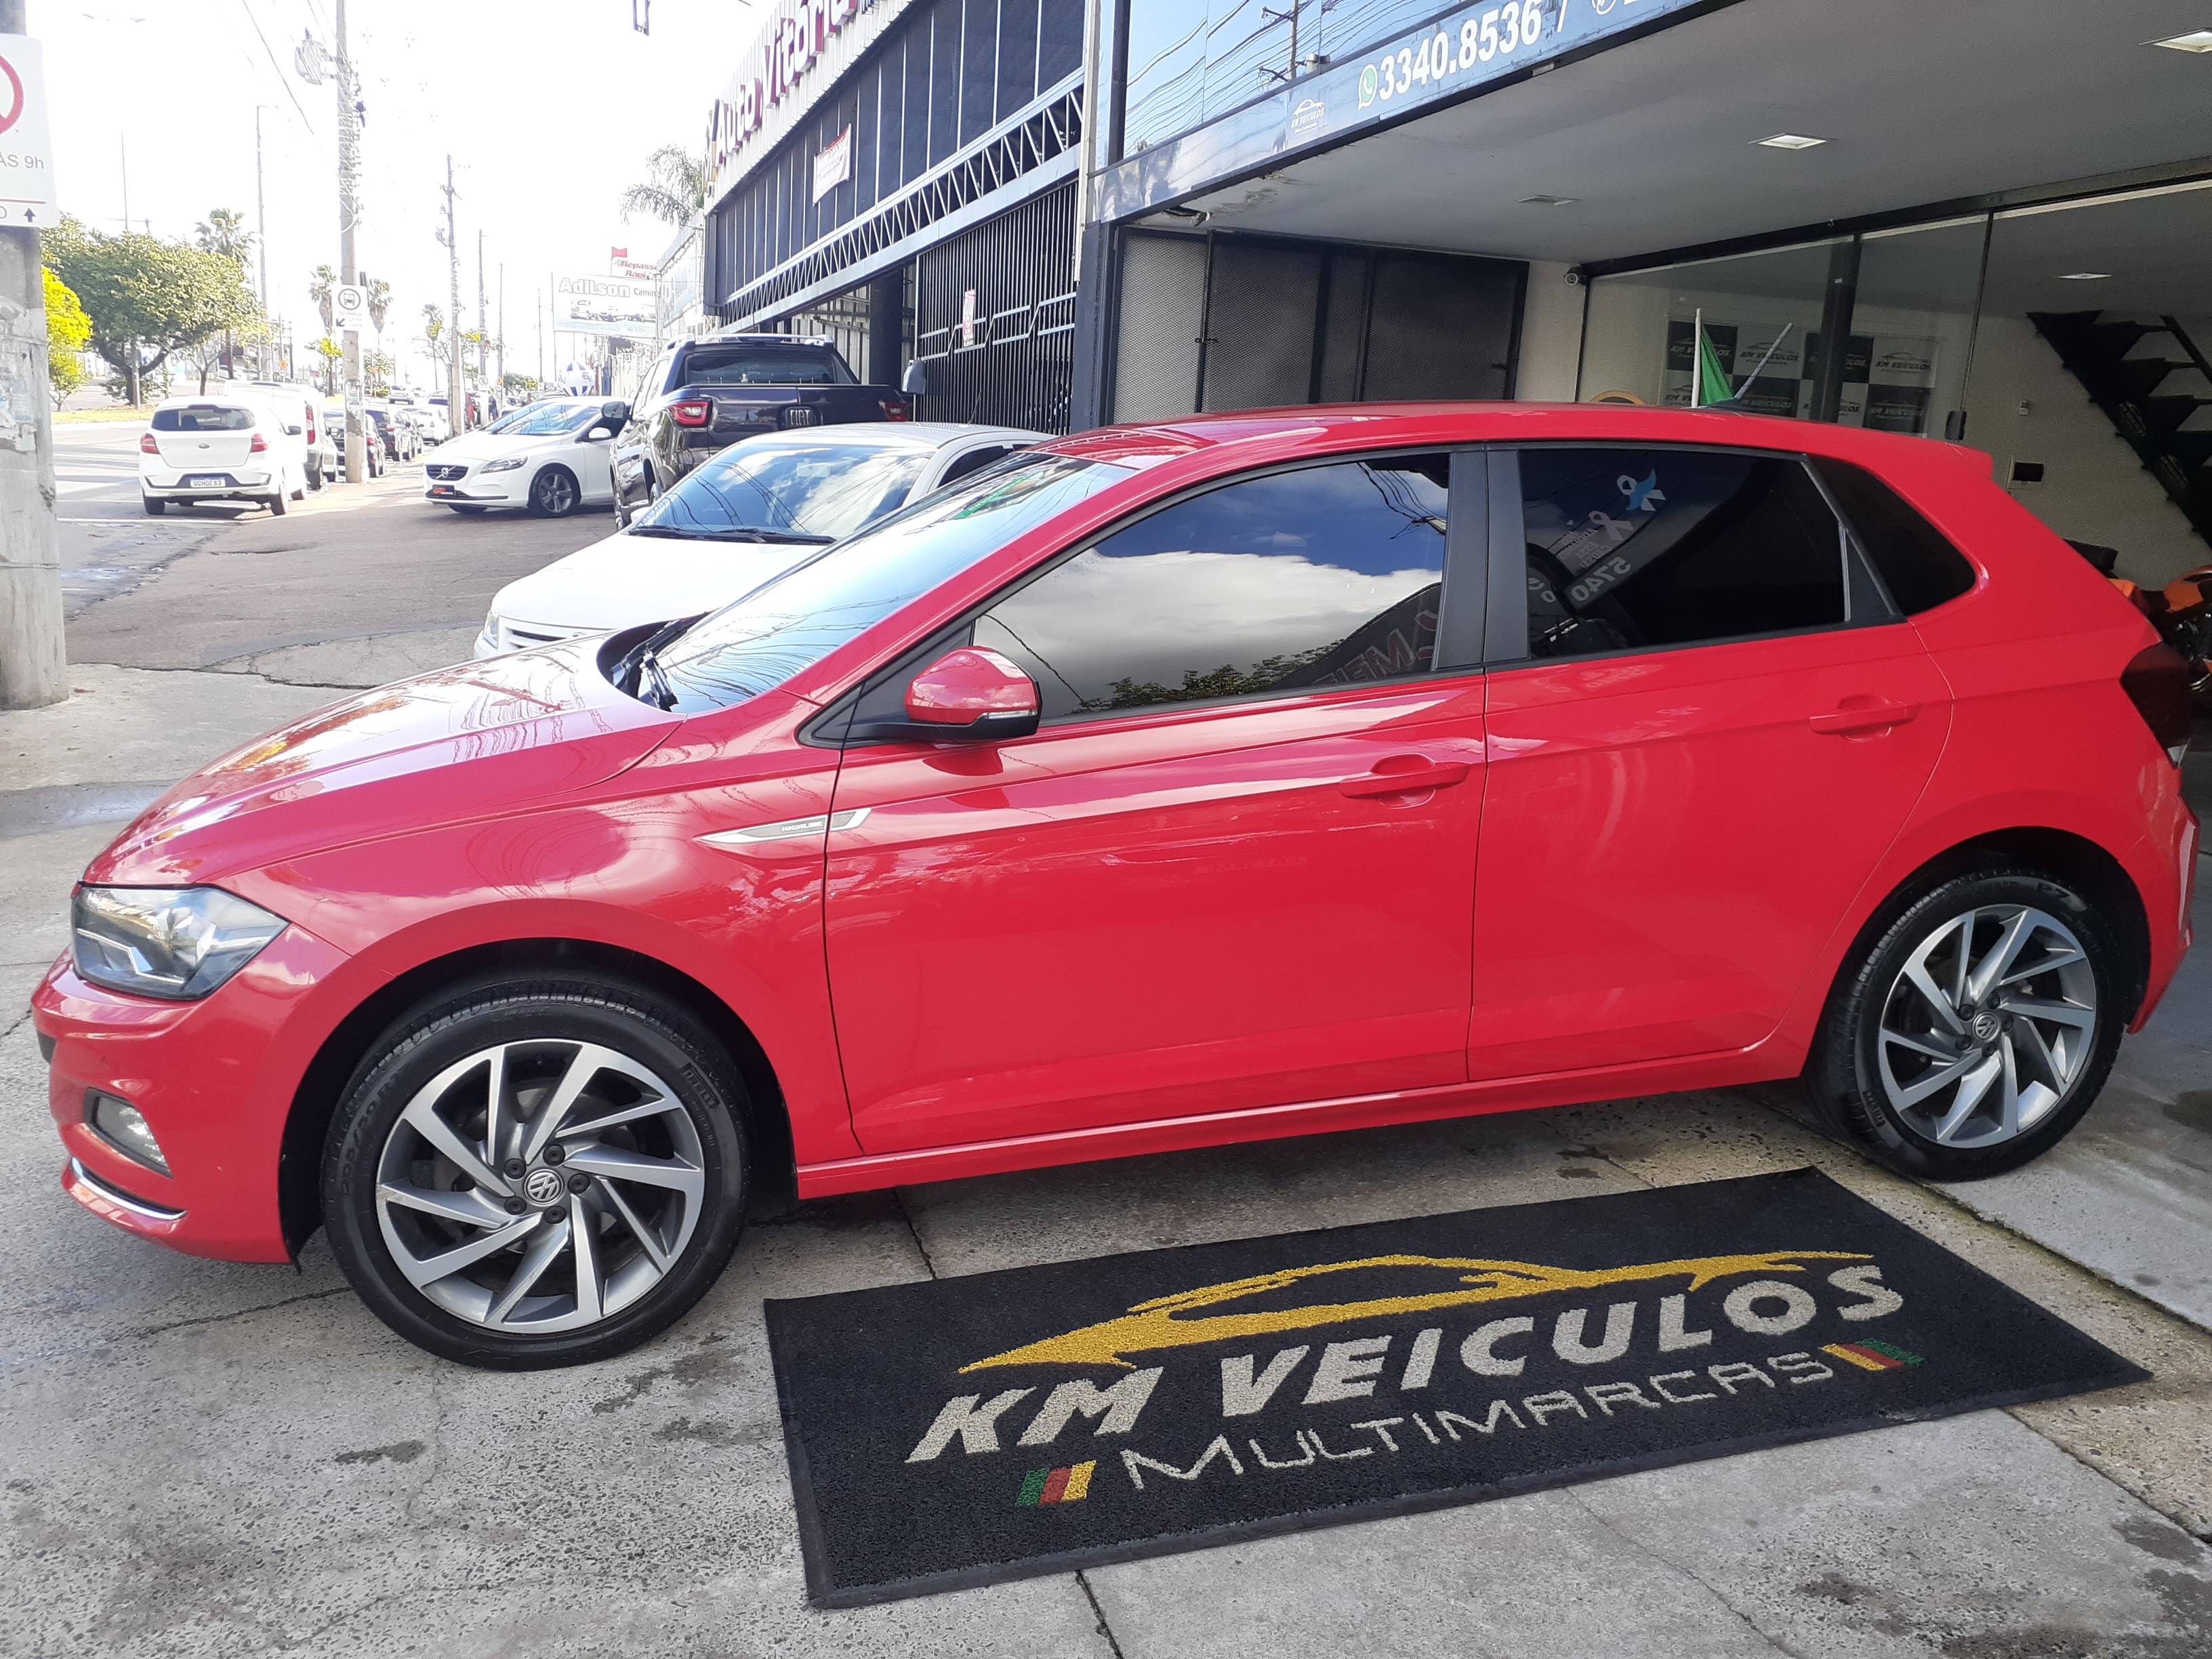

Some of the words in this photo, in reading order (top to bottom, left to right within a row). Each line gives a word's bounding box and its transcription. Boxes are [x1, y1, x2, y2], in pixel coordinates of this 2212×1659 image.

[1378, 0, 1542, 101] 3340.8536
[24, 155, 44, 169] 9h
[716, 76, 762, 167] Auto
[790, 409, 811, 426] FIAT
[904, 1366, 1164, 1464] KM
[1221, 1264, 1904, 1418] VEICULOS
[1120, 1351, 1833, 1490] MULTIMARCAS
